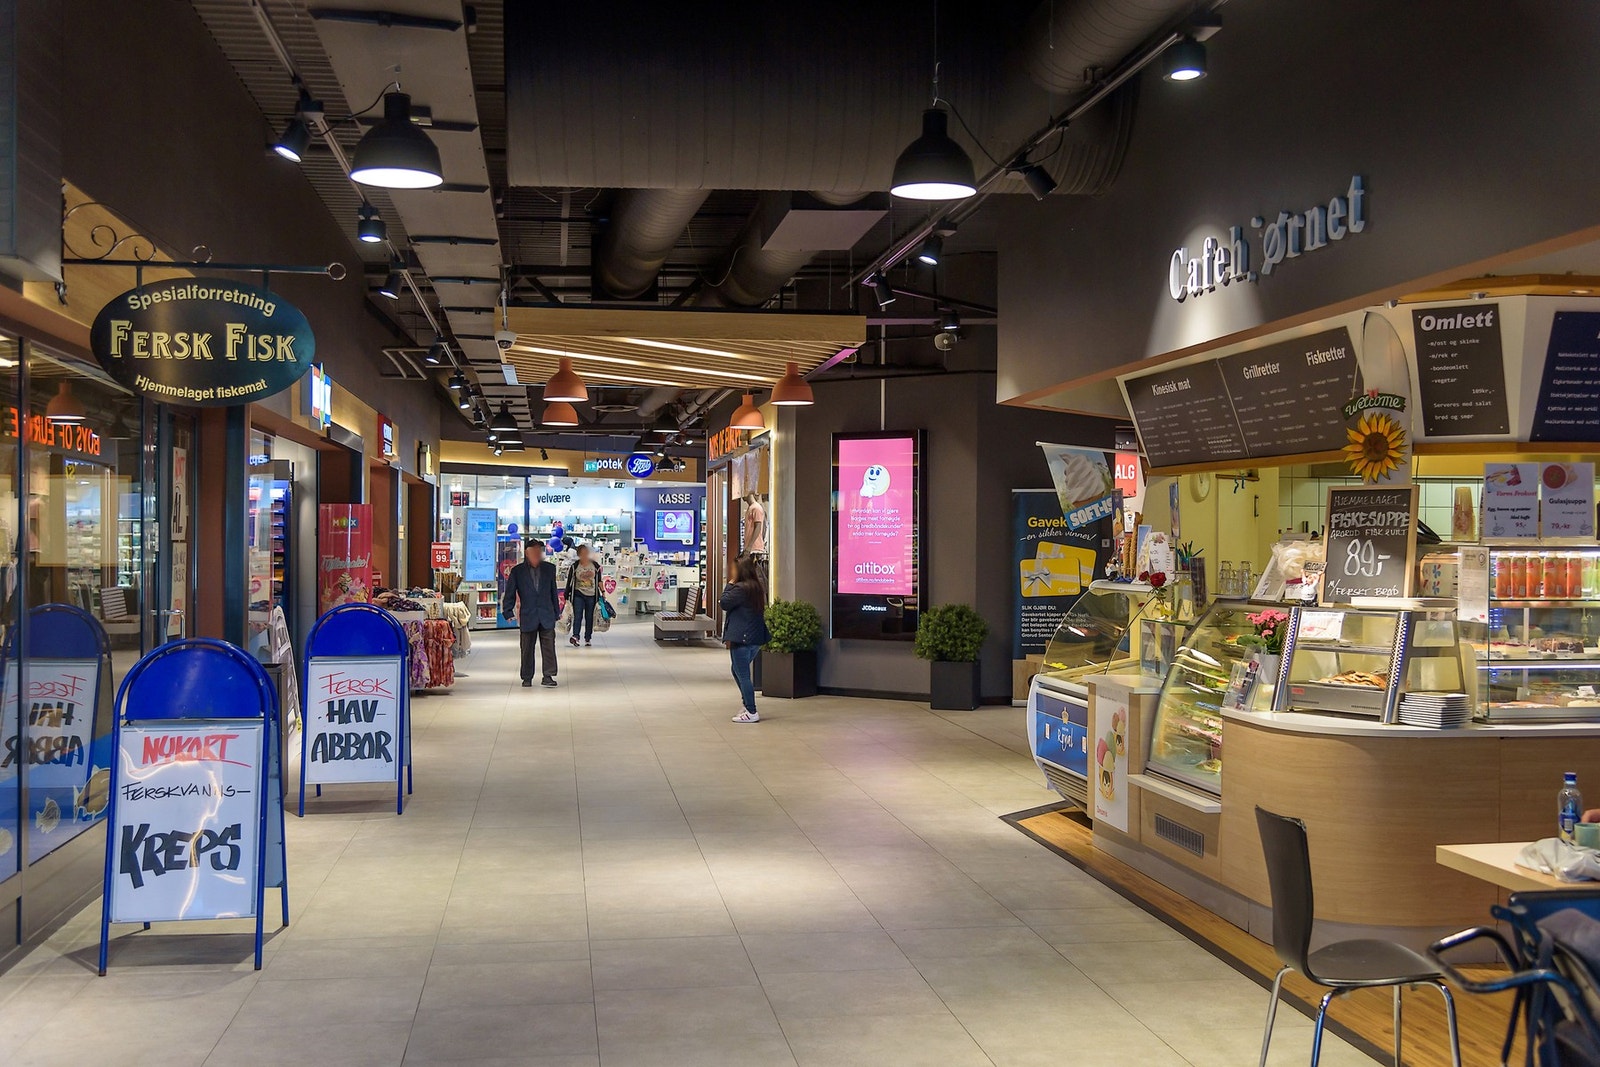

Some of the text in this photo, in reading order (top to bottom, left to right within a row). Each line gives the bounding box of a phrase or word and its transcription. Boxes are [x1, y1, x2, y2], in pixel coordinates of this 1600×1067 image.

[1169, 176, 1364, 300] Cafehørnet
[128, 285, 276, 317] Spesialforretning
[1420, 310, 1493, 331] Omlett
[110, 320, 297, 362] FERSK FISK
[1305, 346, 1346, 366] Fiskretter
[1243, 362, 1280, 380] Grillretter
[135, 375, 268, 401] Hjemmelaget fiskemat
[1151, 378, 1191, 396] Kinesisk mat
[597, 457, 623, 470] potek
[536, 493, 571, 504] velvære
[658, 493, 691, 504] KASSE
[1331, 511, 1410, 529] FISKESUPPE
[1038, 527, 1063, 538] sikker
[854, 562, 895, 575] altibox
[318, 672, 393, 695] FERSK
[311, 730, 393, 764] ABBOR
[120, 822, 242, 889] KREPS
